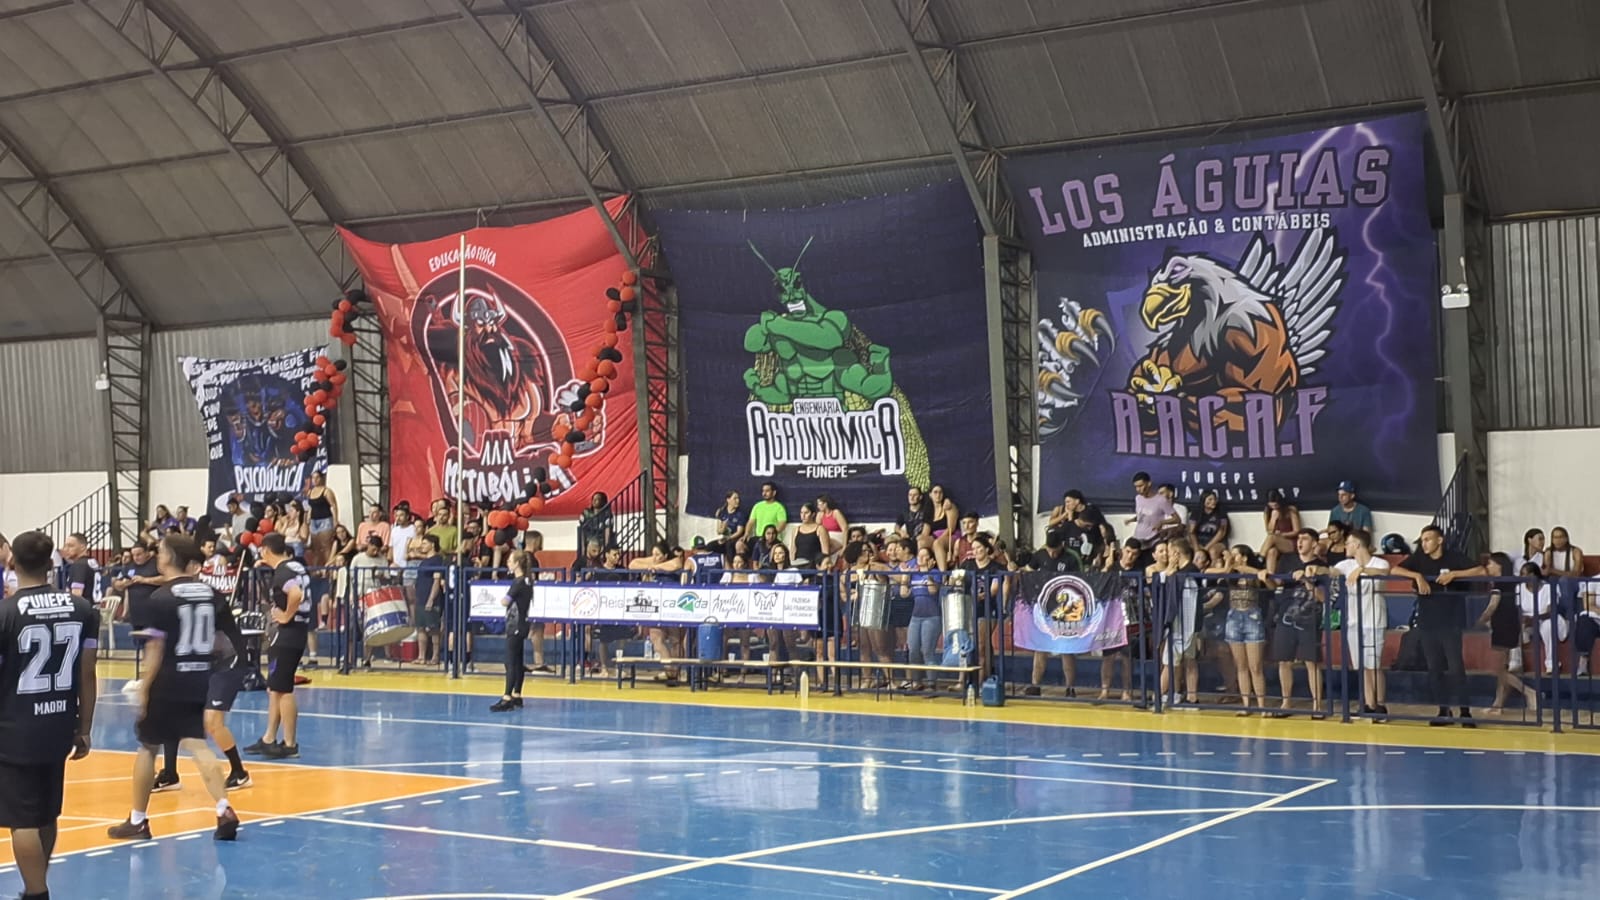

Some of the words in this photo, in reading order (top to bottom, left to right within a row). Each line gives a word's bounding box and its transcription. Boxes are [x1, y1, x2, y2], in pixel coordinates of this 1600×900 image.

[1028, 173, 1125, 235] LOS
[1152, 148, 1390, 218] ÁGUIAS
[1082, 218, 1208, 248] ADMINISTRAÇÃO
[1214, 218, 1226, 233] &
[1232, 212, 1331, 233] CONTÁBEIS
[428, 243, 477, 273] EDUCAÃO
[444, 458, 572, 502] MTABÓLIA
[175, 602, 216, 656] 10
[17, 620, 83, 695] 27
